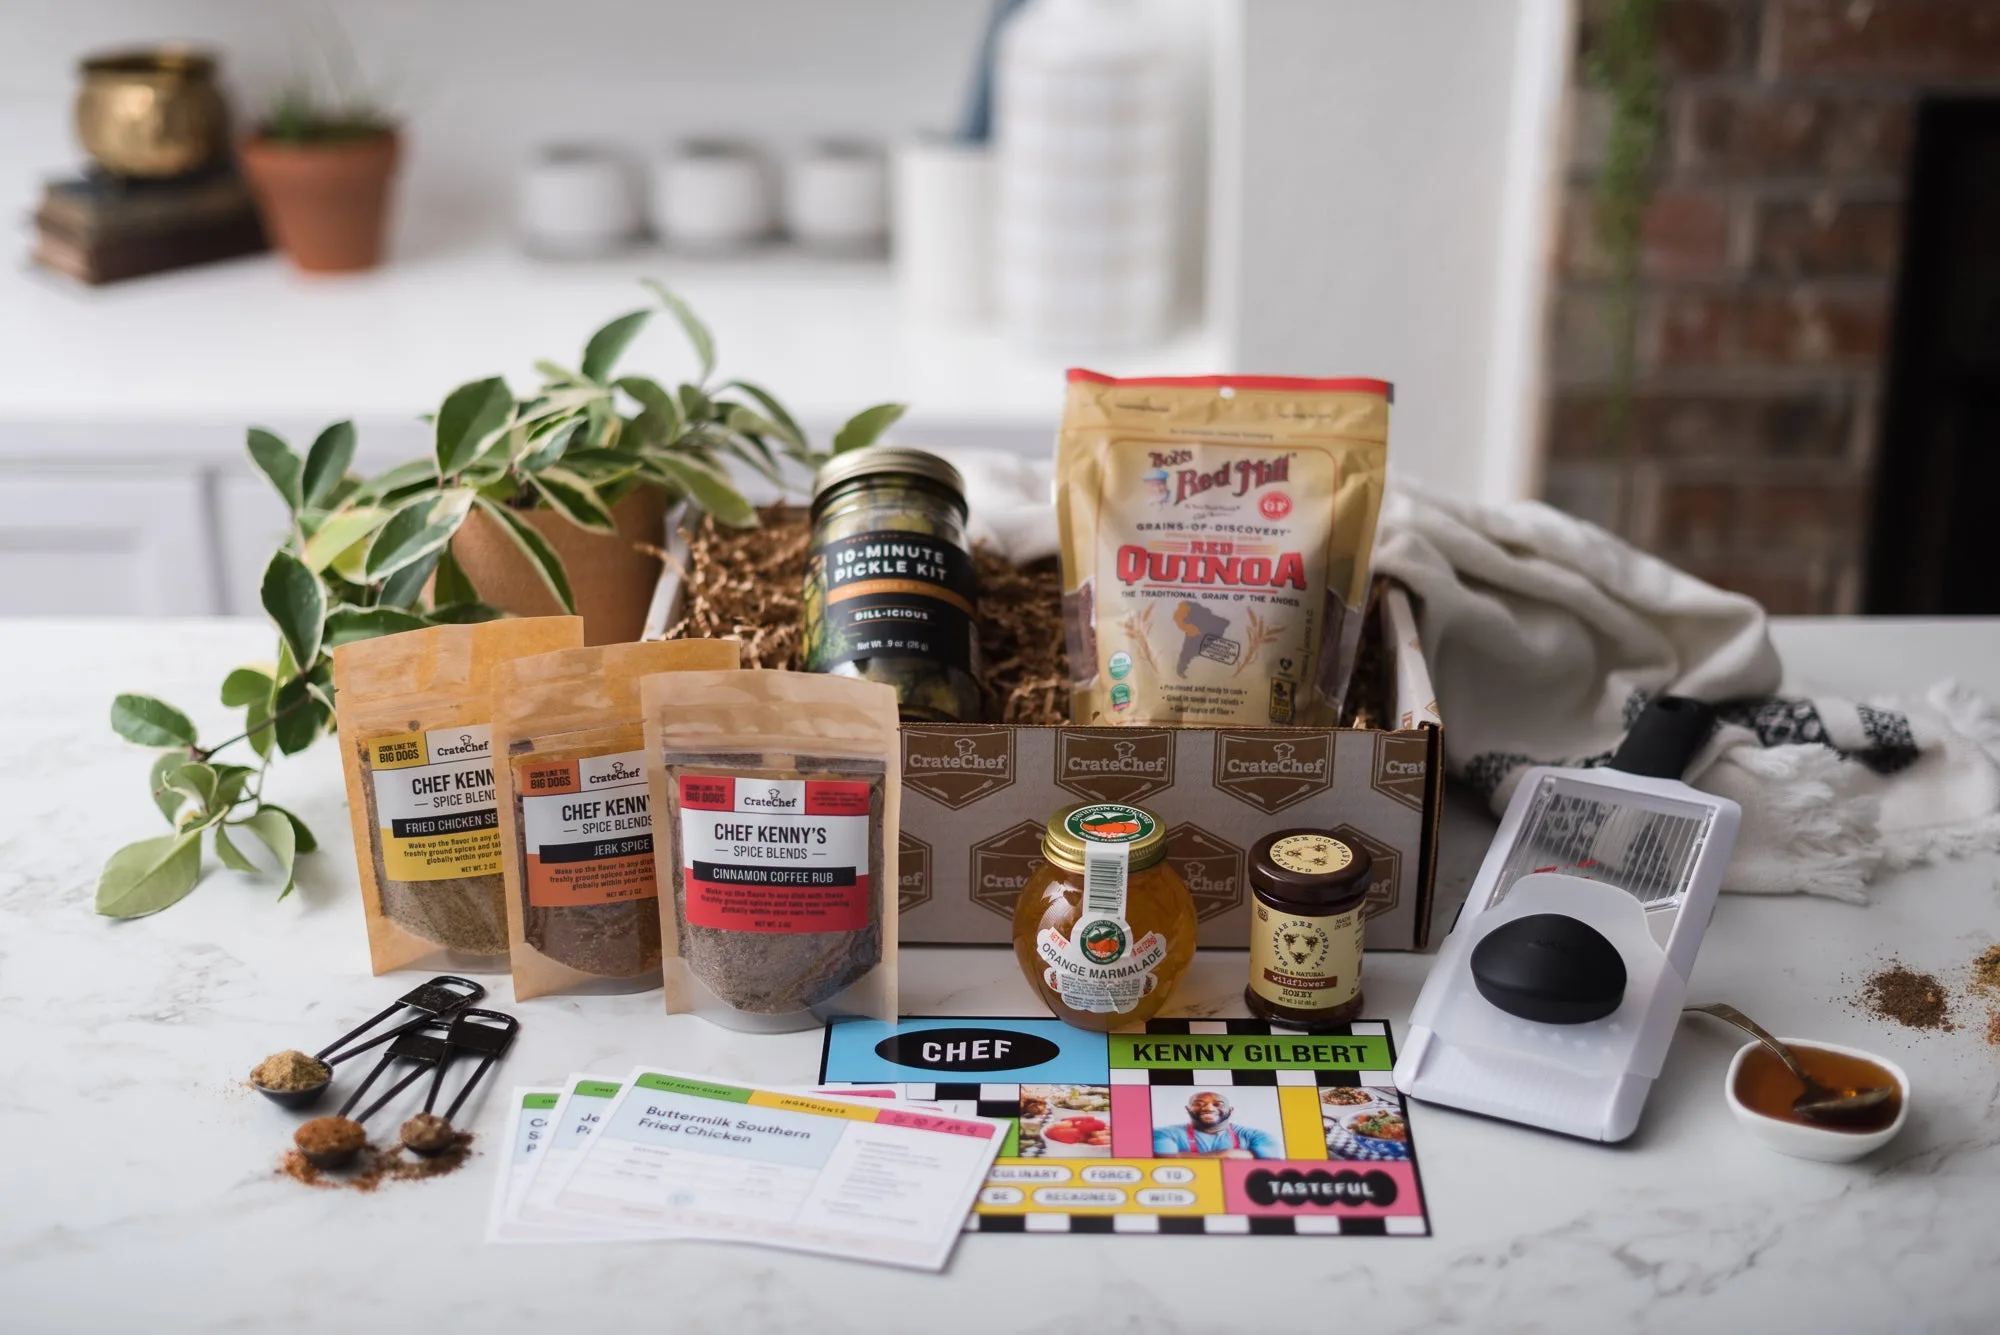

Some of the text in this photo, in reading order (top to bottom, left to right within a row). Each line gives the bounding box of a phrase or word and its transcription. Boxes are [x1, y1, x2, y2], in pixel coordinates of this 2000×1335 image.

[1174, 460, 1232, 506] Red
[836, 544, 944, 566] 10-MINUTE
[1191, 540, 1234, 555] RED
[834, 560, 947, 583] PICKLE KIT
[1117, 544, 1307, 591] QUINOA
[1122, 590, 1300, 607] THE TRADITIONAL GRAIN OF THE ANDES
[855, 609, 929, 621] DILL-ICIOUS
[380, 749, 420, 763] BIG DOGS
[437, 741, 489, 756] CrateChef
[909, 752, 1008, 770] CrateChef
[1068, 756, 1167, 773] CrateChef
[1226, 759, 1326, 775] CrateChef
[530, 776, 572, 790] BIG DOGS
[590, 768, 641, 784] CrateChef
[412, 775, 451, 795] CHEF
[433, 794, 463, 808] SPICE
[744, 797, 797, 808] CrateChef
[562, 802, 601, 822] CHEF
[406, 821, 435, 834] FRIED
[438, 816, 483, 831] CHICKEN
[582, 821, 612, 835] SPICE
[714, 823, 827, 845] CHEF KENNY'S
[593, 838, 650, 857] JERK SPICE
[734, 845, 808, 860] SPICE BLENDS
[713, 868, 834, 883] CINNAMON COFFEE RUB
[1292, 921, 1313, 929] BEE
[1042, 943, 1163, 979] ORANGE MARMALADE
[1274, 966, 1289, 975] PURE
[1272, 975, 1326, 987] wildflower
[1282, 988, 1313, 998] HONEY
[922, 1039, 1013, 1062] CHEF
[1133, 1042, 1369, 1063] KENNY GILBERT
[656, 1080, 675, 1088] CHEF
[676, 1082, 701, 1091] KENNY
[780, 1099, 847, 1114] INGREDIENTS
[638, 1118, 753, 1144] Fried Chicken
[646, 1106, 811, 1140] Buttermilk Southern
[992, 1169, 1182, 1180] CULINARY FORCE TO
[1268, 1180, 1375, 1198] TASTEFUL
[992, 1192, 1184, 1203] BE RECKONED WITH
